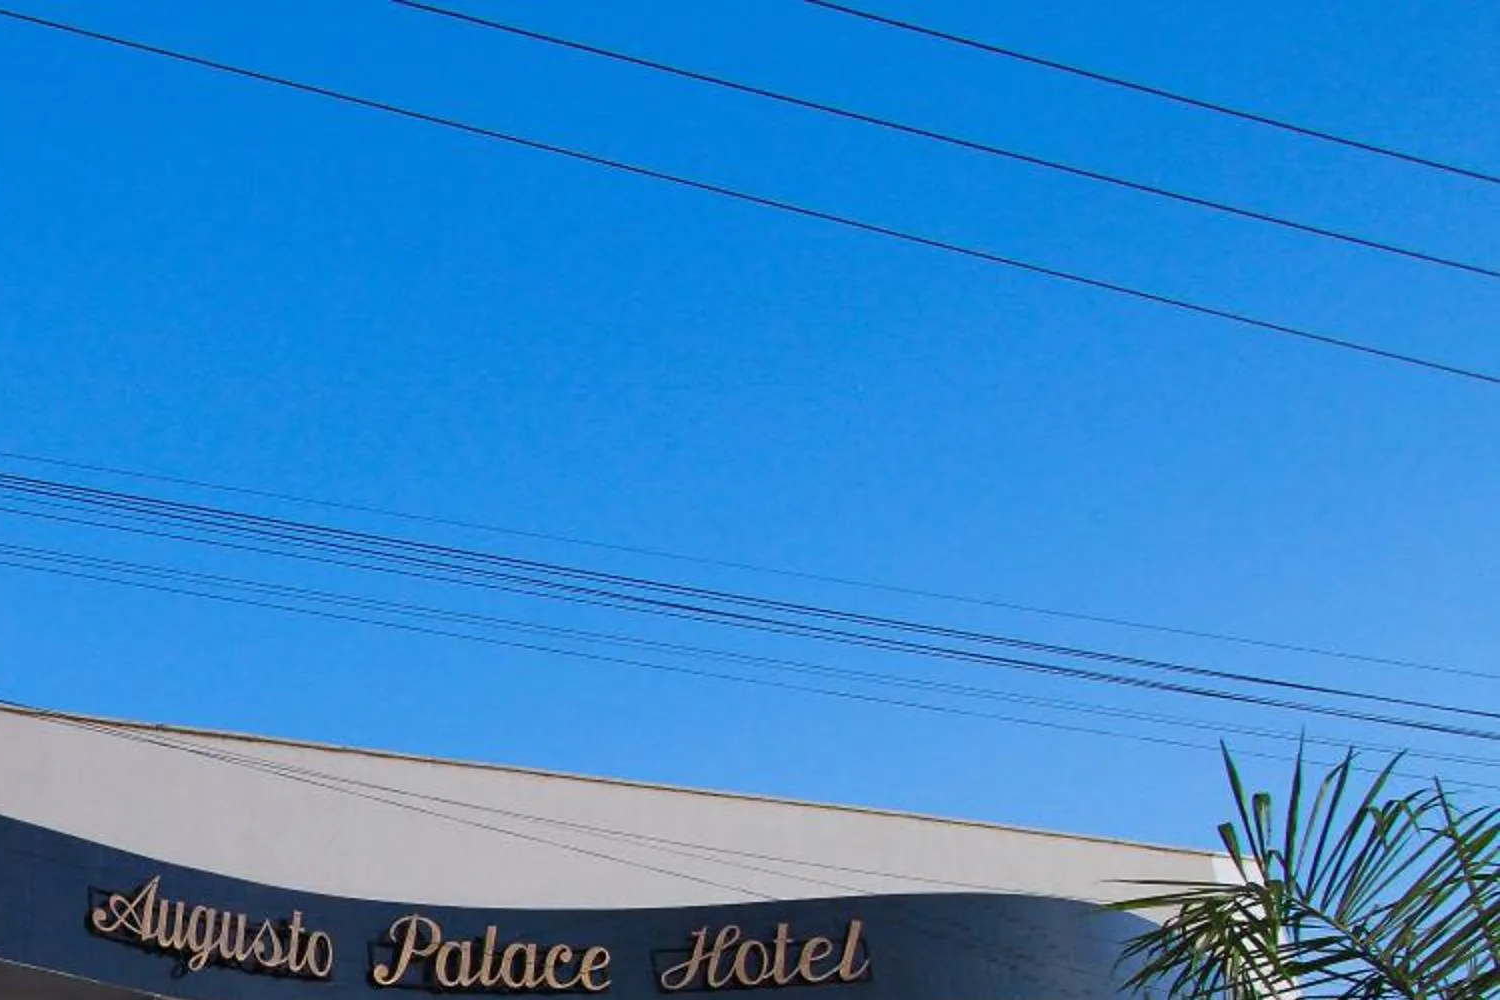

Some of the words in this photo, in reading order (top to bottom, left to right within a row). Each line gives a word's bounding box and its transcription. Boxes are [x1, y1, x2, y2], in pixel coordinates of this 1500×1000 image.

[91, 874, 334, 977] Augusto
[372, 912, 613, 993] Palace
[660, 918, 871, 993] Hotel
